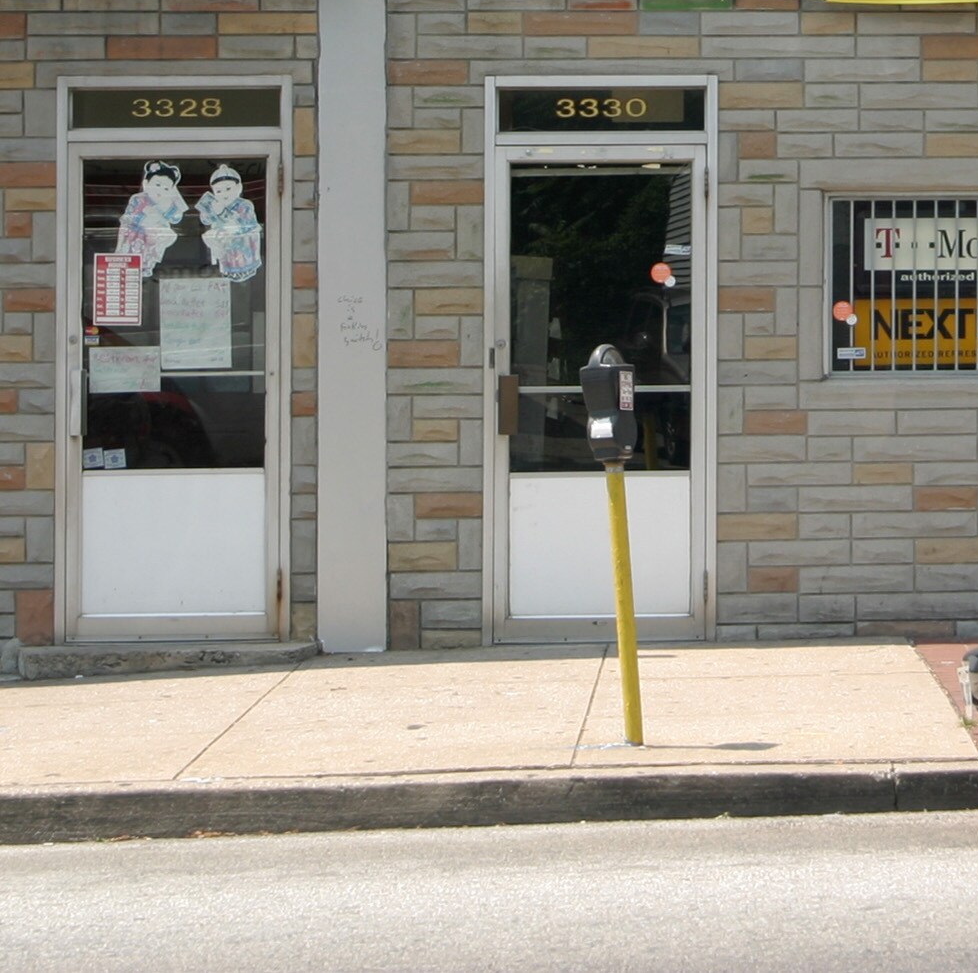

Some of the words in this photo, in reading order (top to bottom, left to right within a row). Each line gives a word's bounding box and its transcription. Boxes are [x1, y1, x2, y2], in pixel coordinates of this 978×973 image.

[131, 98, 222, 118] 3328
[555, 98, 647, 118] 3330
[901, 272, 975, 282] authorized
[873, 350, 934, 359] AUTORZED
